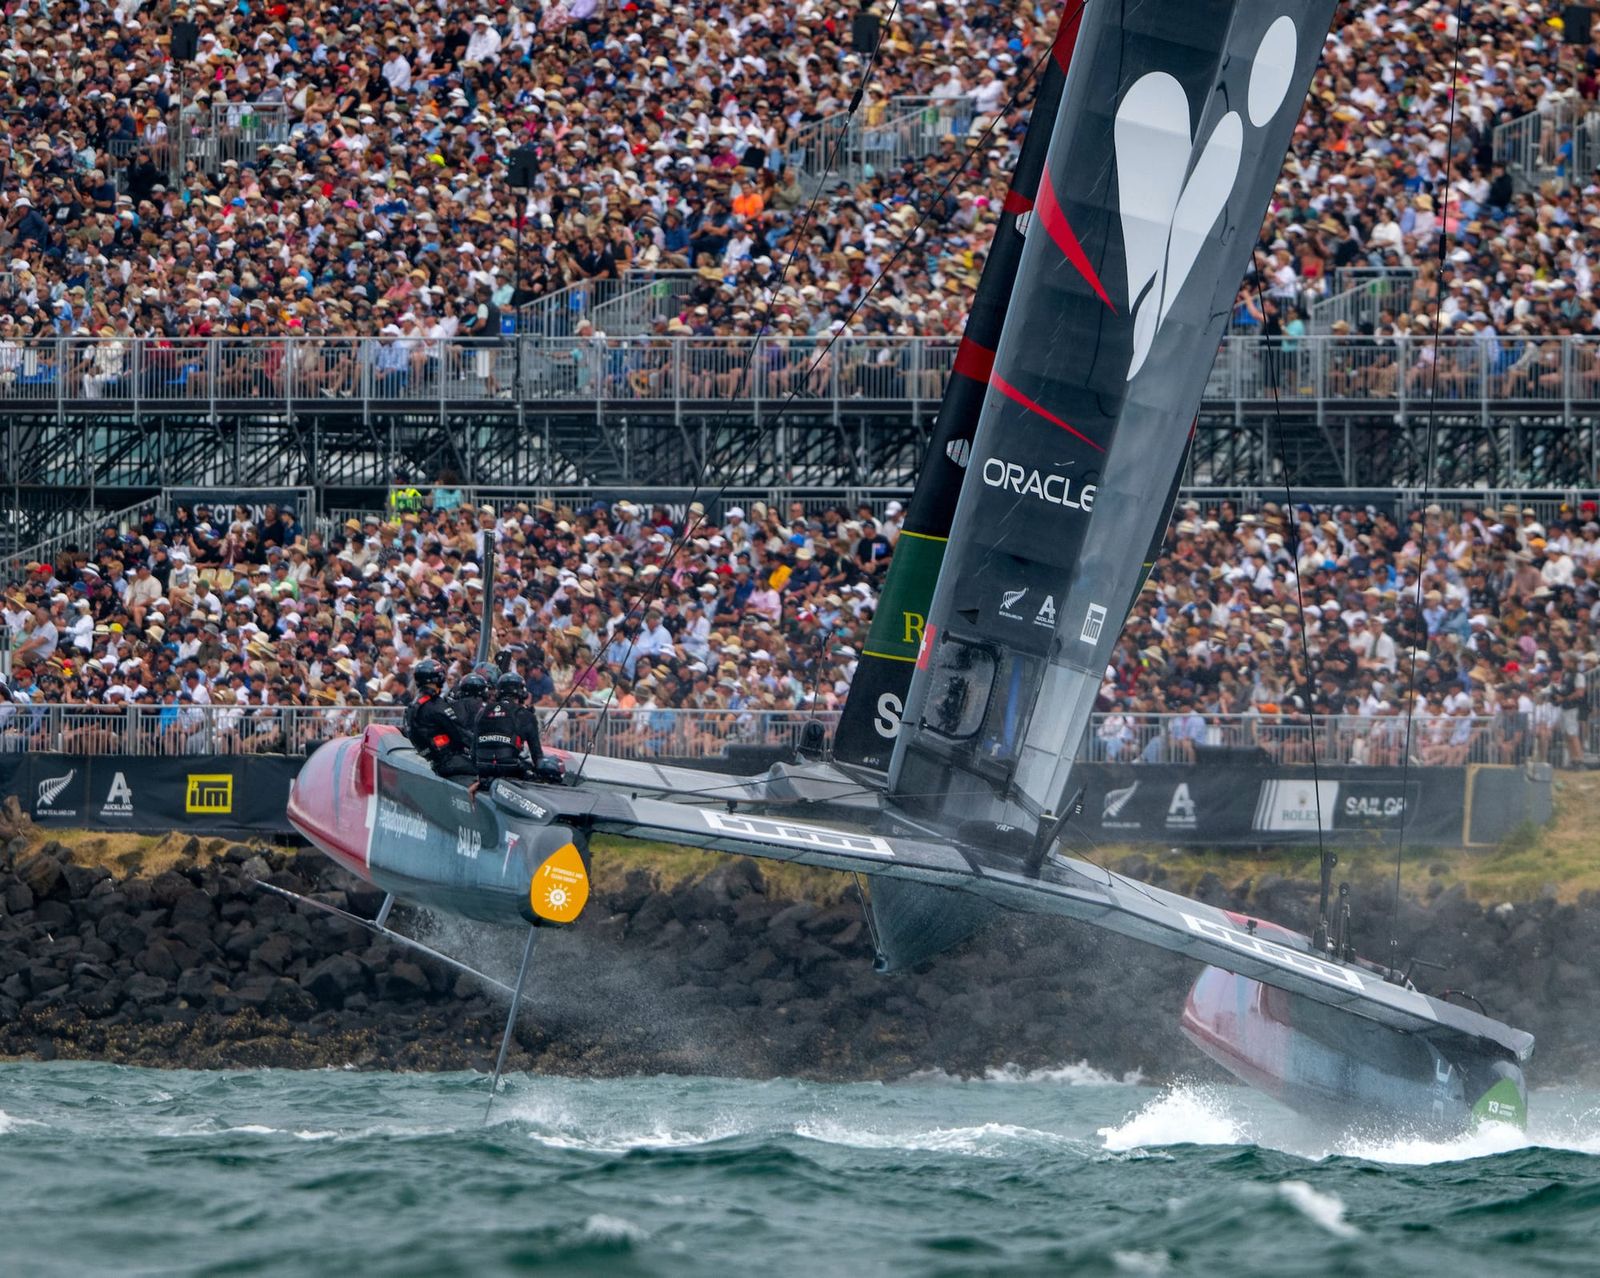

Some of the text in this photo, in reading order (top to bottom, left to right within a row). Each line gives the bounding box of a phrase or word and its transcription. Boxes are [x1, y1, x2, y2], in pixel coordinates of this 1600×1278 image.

[983, 457, 1097, 513] ORACLE
[479, 734, 511, 744] SCHNEITER
[103, 803, 134, 811] AUCKLAND
[543, 864, 552, 877] 7
